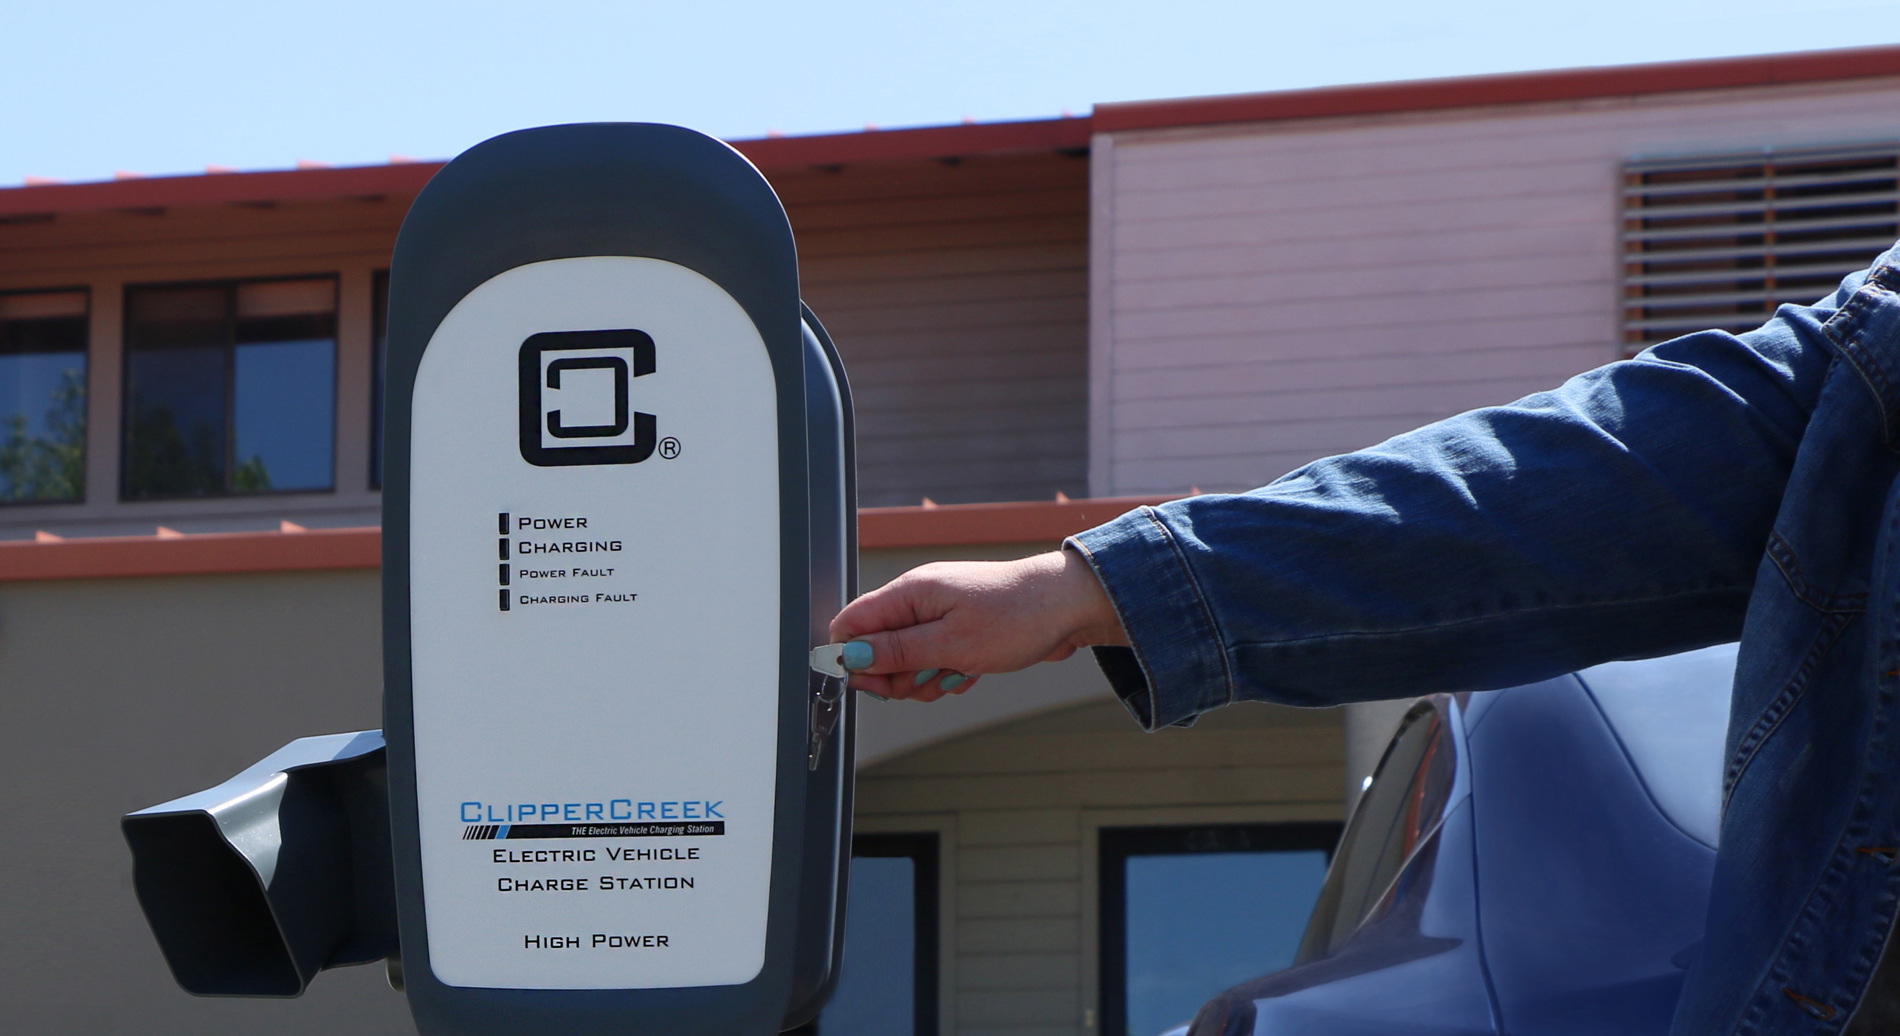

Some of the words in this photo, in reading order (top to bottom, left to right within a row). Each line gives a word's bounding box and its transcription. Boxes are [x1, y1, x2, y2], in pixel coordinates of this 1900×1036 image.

[518, 517, 588, 531] POWER
[518, 540, 622, 555] CHARGING
[519, 569, 566, 579] POWER
[572, 567, 615, 578] FAULT
[519, 594, 589, 605] CHARGING
[595, 593, 638, 603] FAULT
[460, 799, 725, 823] CLIPPERCREEK
[571, 826, 586, 836] THE
[588, 826, 618, 835] Electric
[619, 825, 648, 835] Vehicle
[649, 825, 685, 836] Charging
[686, 824, 715, 834] Station
[493, 848, 596, 863] ELECTRIC
[605, 847, 700, 861] VEHICLE
[498, 877, 589, 892] CHARGE
[599, 876, 695, 891] STATION
[524, 934, 580, 949] HIGH
[592, 933, 669, 948] POWER
